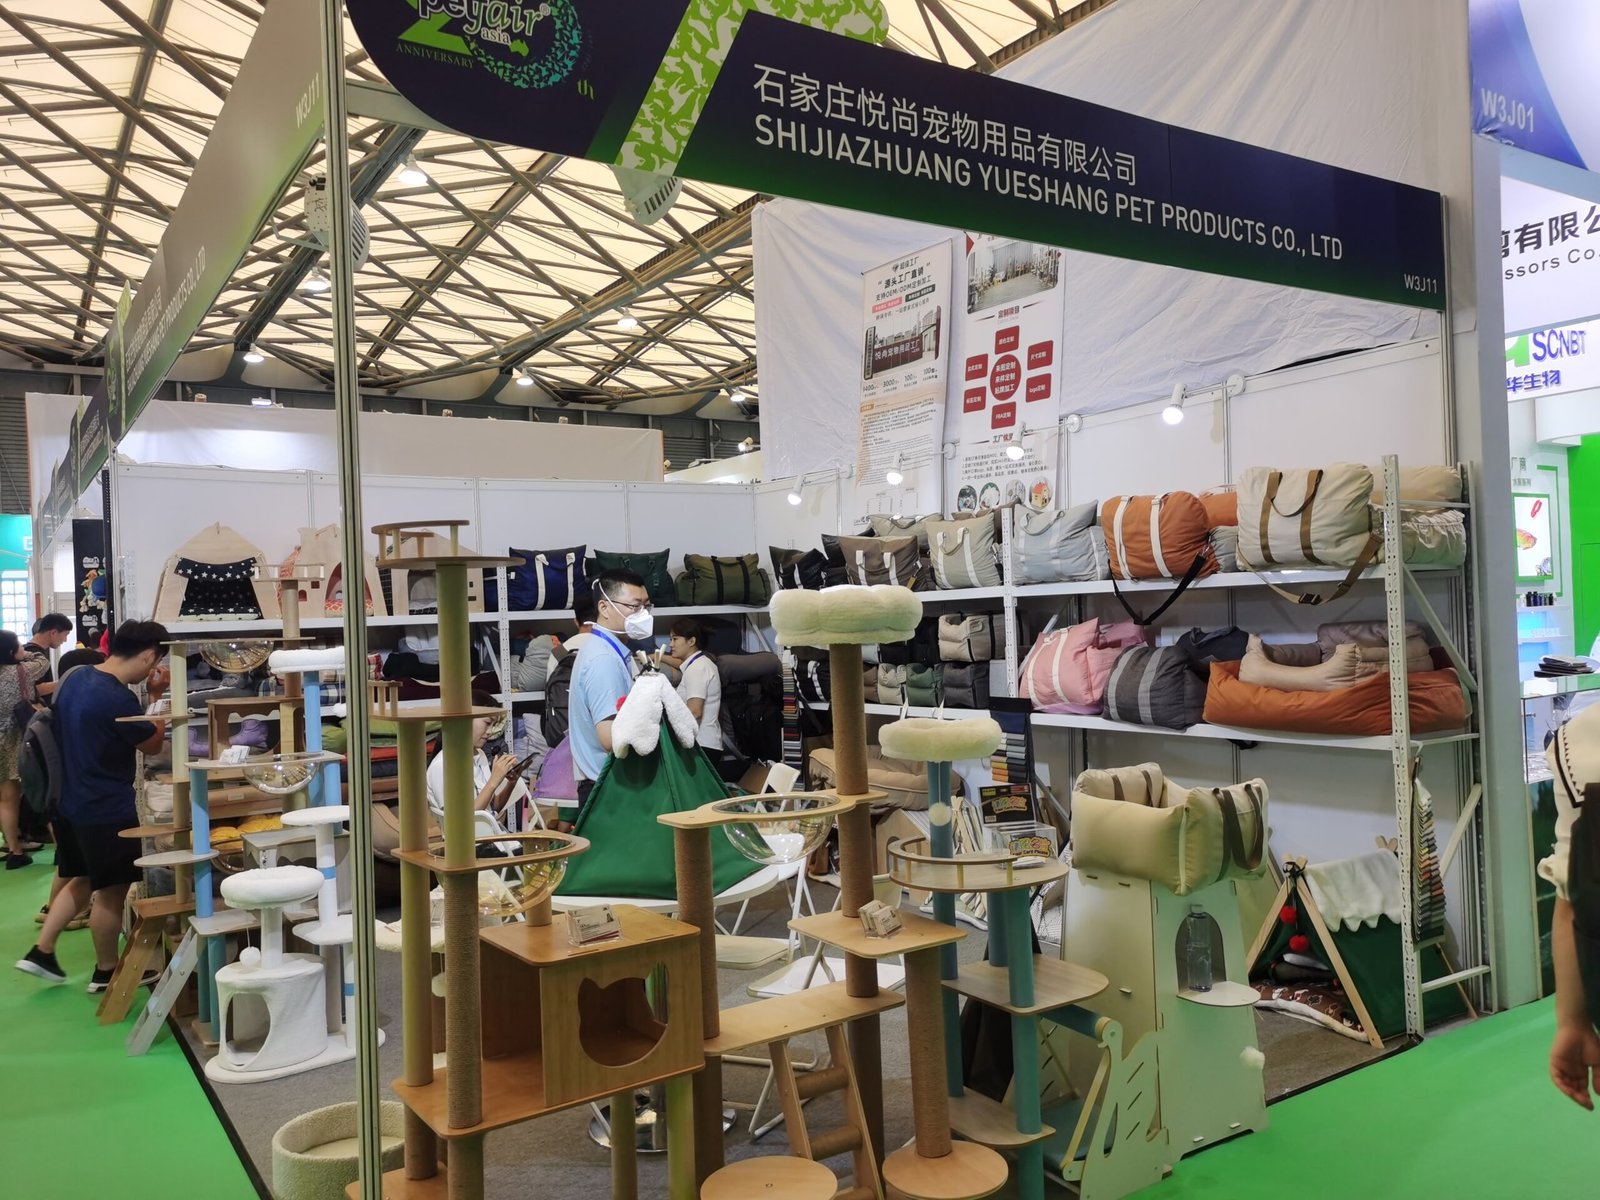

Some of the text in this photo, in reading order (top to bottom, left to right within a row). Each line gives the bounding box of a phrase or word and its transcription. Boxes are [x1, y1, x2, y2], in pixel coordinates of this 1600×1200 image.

[481, 27, 512, 46] asia
[396, 43, 475, 69] ANNIVERSARY
[1481, 87, 1535, 133] W3J01
[753, 63, 1136, 186] 石家庄悦尚宠物用品有限公司
[755, 113, 1343, 260] SHIJIAZHUANG YUESHANG PET PRODUCTS CO., LTD
[1505, 257, 1560, 280] ssors
[1403, 273, 1437, 294] W3J11
[1532, 329, 1586, 362] SCNBT
[1505, 369, 1561, 392] 华生物
